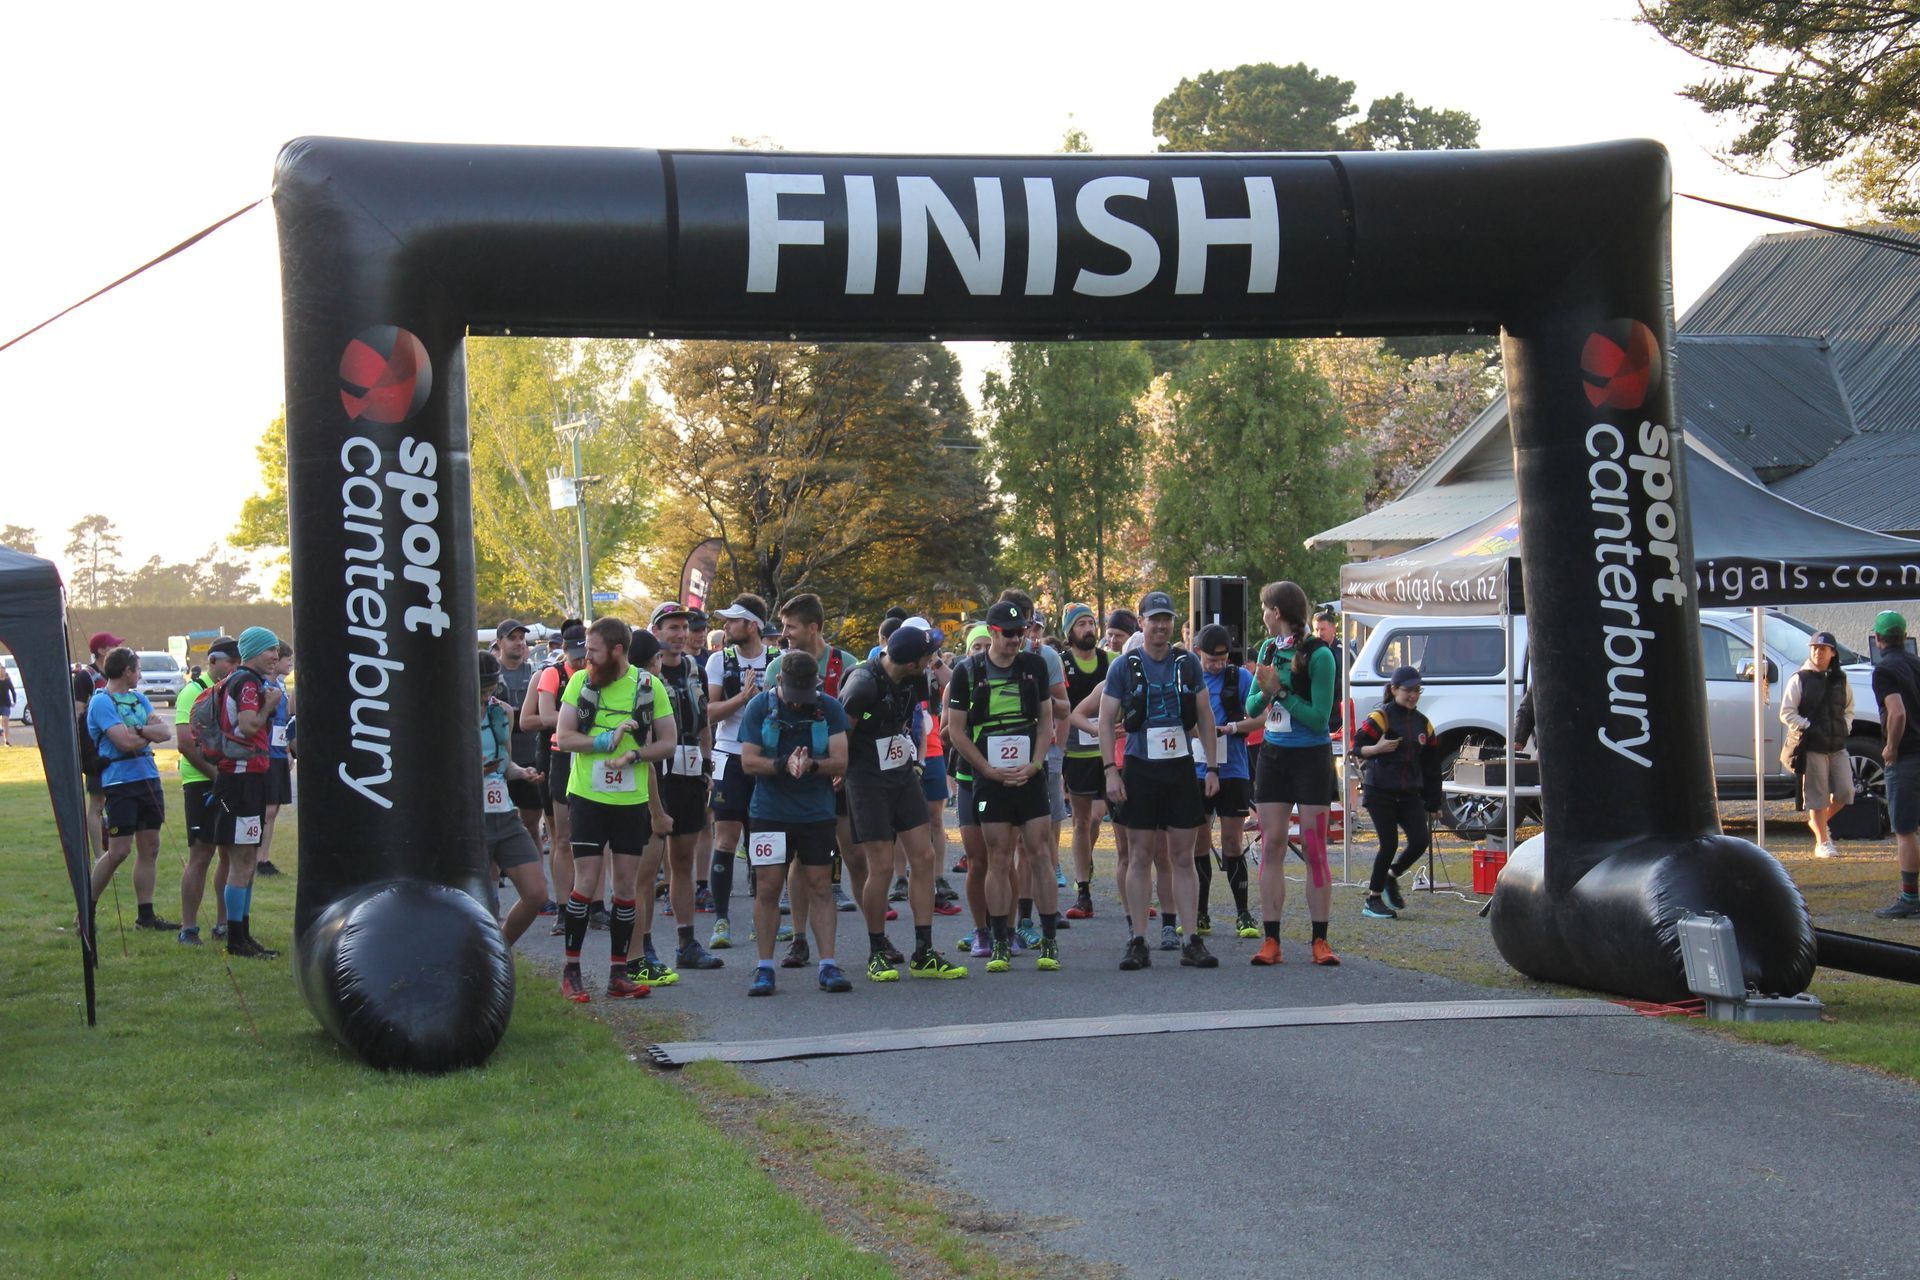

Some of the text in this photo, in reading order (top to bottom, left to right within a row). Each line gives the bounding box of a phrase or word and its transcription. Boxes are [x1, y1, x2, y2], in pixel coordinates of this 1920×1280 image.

[745, 172, 1280, 297] FINISH
[1628, 420, 1688, 606] sport
[385, 436, 451, 637] sport
[1585, 422, 1655, 768] canterbury
[338, 436, 405, 809] canterbury
[1161, 737, 1177, 751] 14
[890, 745, 903, 760] 55
[1000, 746, 1019, 760] 22
[604, 771, 623, 785] 54
[487, 790, 502, 804] 63
[246, 825, 259, 838] 49
[755, 843, 773, 857] 66
